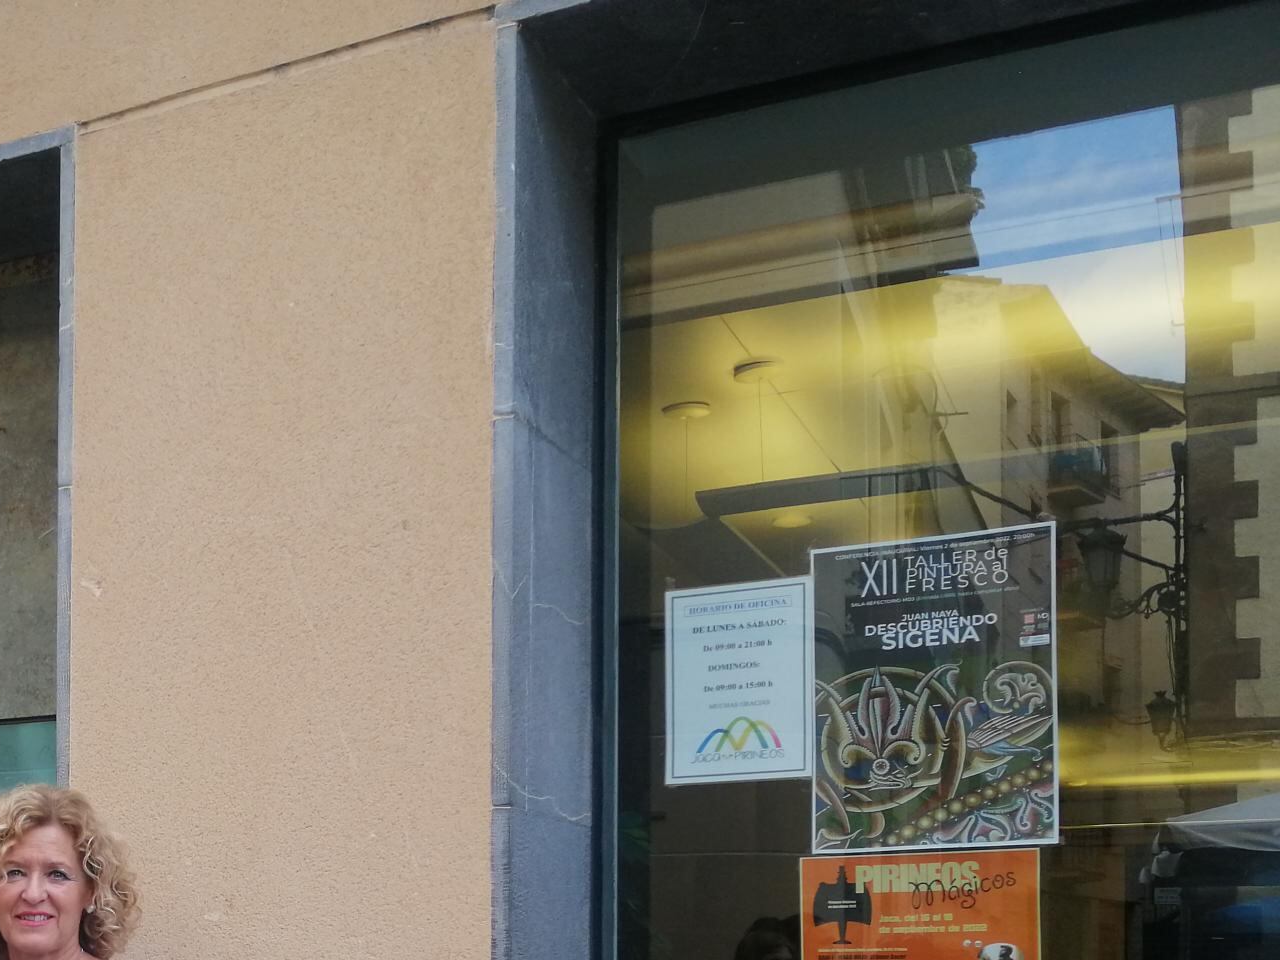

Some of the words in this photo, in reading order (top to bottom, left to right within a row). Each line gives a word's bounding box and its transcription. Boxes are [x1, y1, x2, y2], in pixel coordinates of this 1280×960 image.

[860, 557, 898, 598] XII
[904, 549, 978, 570] TALLER
[984, 546, 1009, 561] de
[906, 560, 987, 583] PINTURA
[992, 554, 1008, 572] al
[905, 569, 1009, 594] FRESCO
[689, 603, 732, 615] HORARIO
[734, 601, 745, 610] DE
[748, 598, 788, 609] OFICINA
[901, 612, 930, 622] JUAN
[931, 609, 960, 620] NAYA
[692, 626, 706, 635] DE
[707, 623, 736, 633] LUNES
[739, 622, 745, 630] A
[864, 612, 999, 637] DESCUBRIENDO
[703, 644, 713, 653] De
[715, 642, 736, 652] 09:00
[744, 640, 766, 649] 21:00
[767, 639, 773, 647] h
[881, 625, 981, 651] SIGENA
[707, 661, 760, 673] DOMINGOS:
[704, 685, 713, 693] De
[715, 683, 737, 692] 09:00
[746, 681, 766, 690] 15:00
[768, 680, 773, 688] h
[734, 749, 785, 761] PIRINEOS
[855, 861, 982, 893] PIRINEOS
[908, 871, 1017, 909] Mágicos
